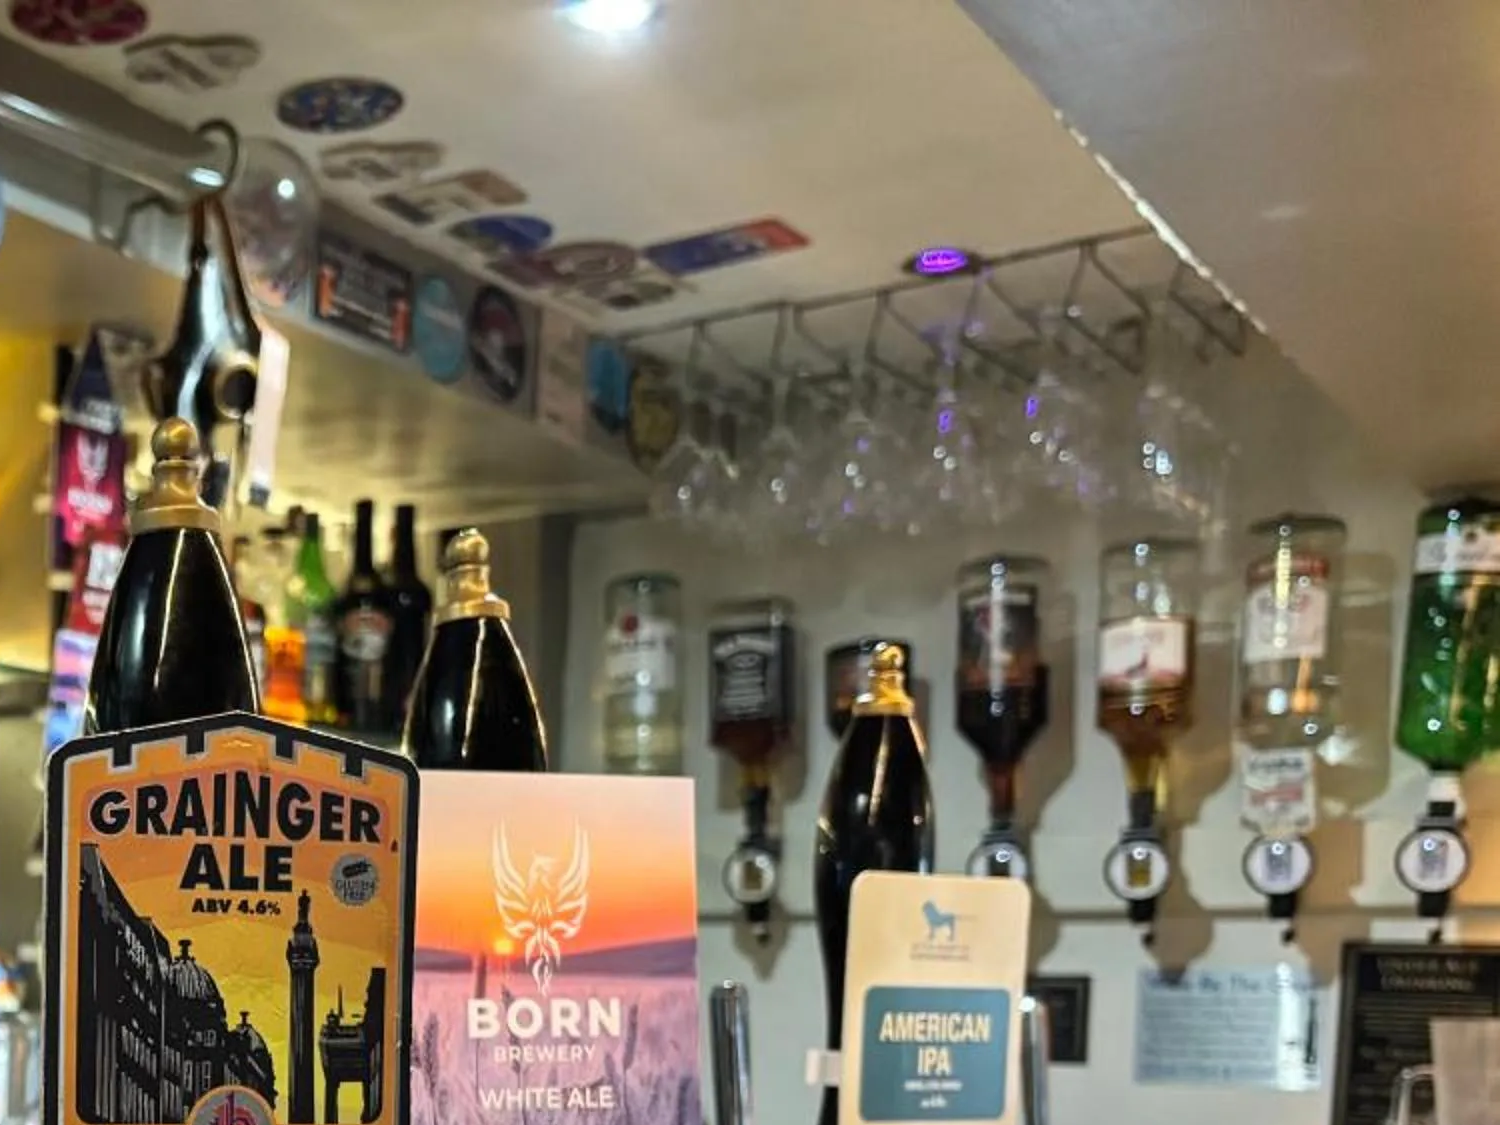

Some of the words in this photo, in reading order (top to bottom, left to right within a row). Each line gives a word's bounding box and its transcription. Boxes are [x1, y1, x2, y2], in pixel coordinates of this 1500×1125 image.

[90, 771, 381, 843] GRAINGER
[180, 843, 293, 892] ALE
[192, 898, 230, 914] ABV
[236, 898, 281, 915] 4.6%
[467, 997, 622, 1039] BORN
[879, 1011, 991, 1043] AMERICAN
[494, 1044, 596, 1063] BREWERY
[917, 1046, 952, 1076] IPA
[479, 1087, 561, 1110] WHITE
[566, 1086, 615, 1109] ALE
